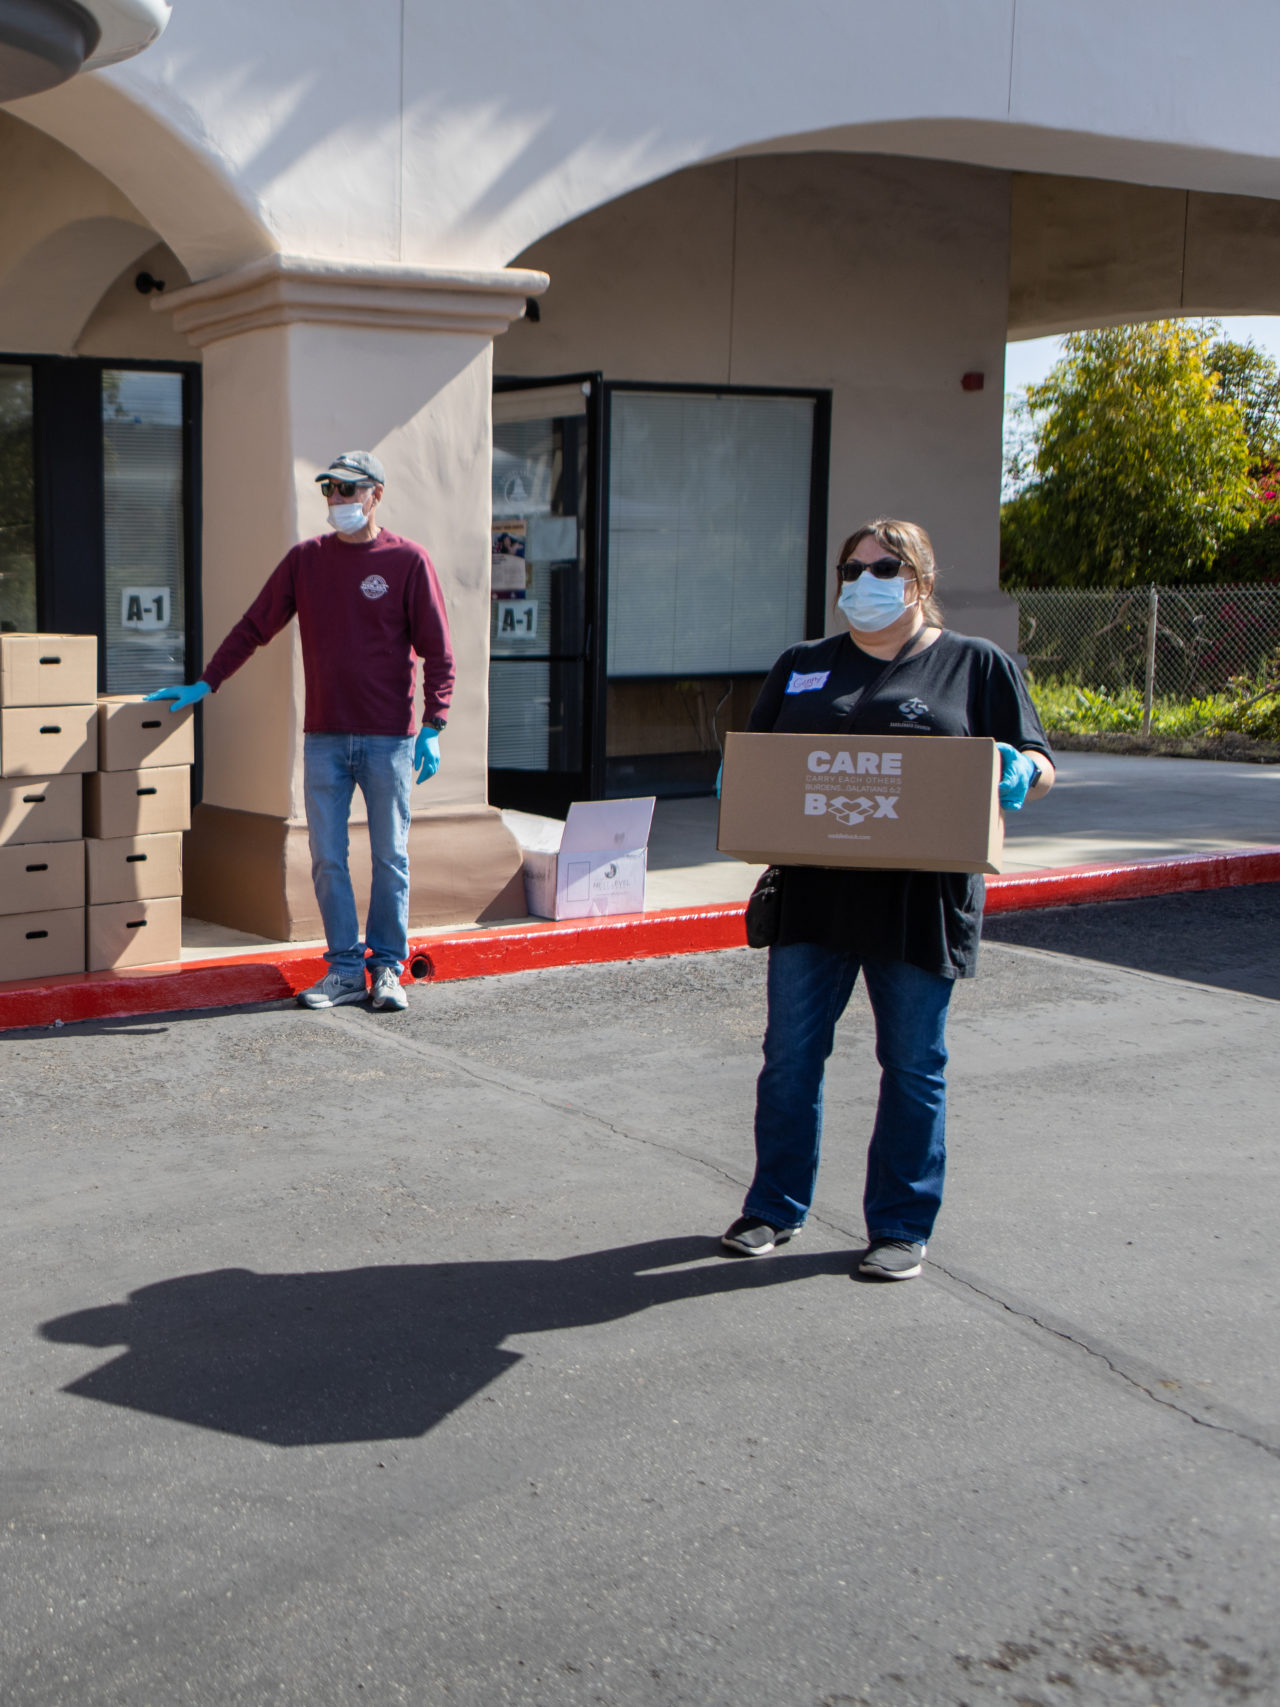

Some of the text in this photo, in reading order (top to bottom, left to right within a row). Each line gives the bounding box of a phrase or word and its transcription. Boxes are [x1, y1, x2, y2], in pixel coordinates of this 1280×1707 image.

[127, 595, 164, 621] A-1
[502, 607, 533, 632] A-1
[807, 750, 903, 775] CARE
[805, 774, 903, 785] CARRY EACH OTHERS
